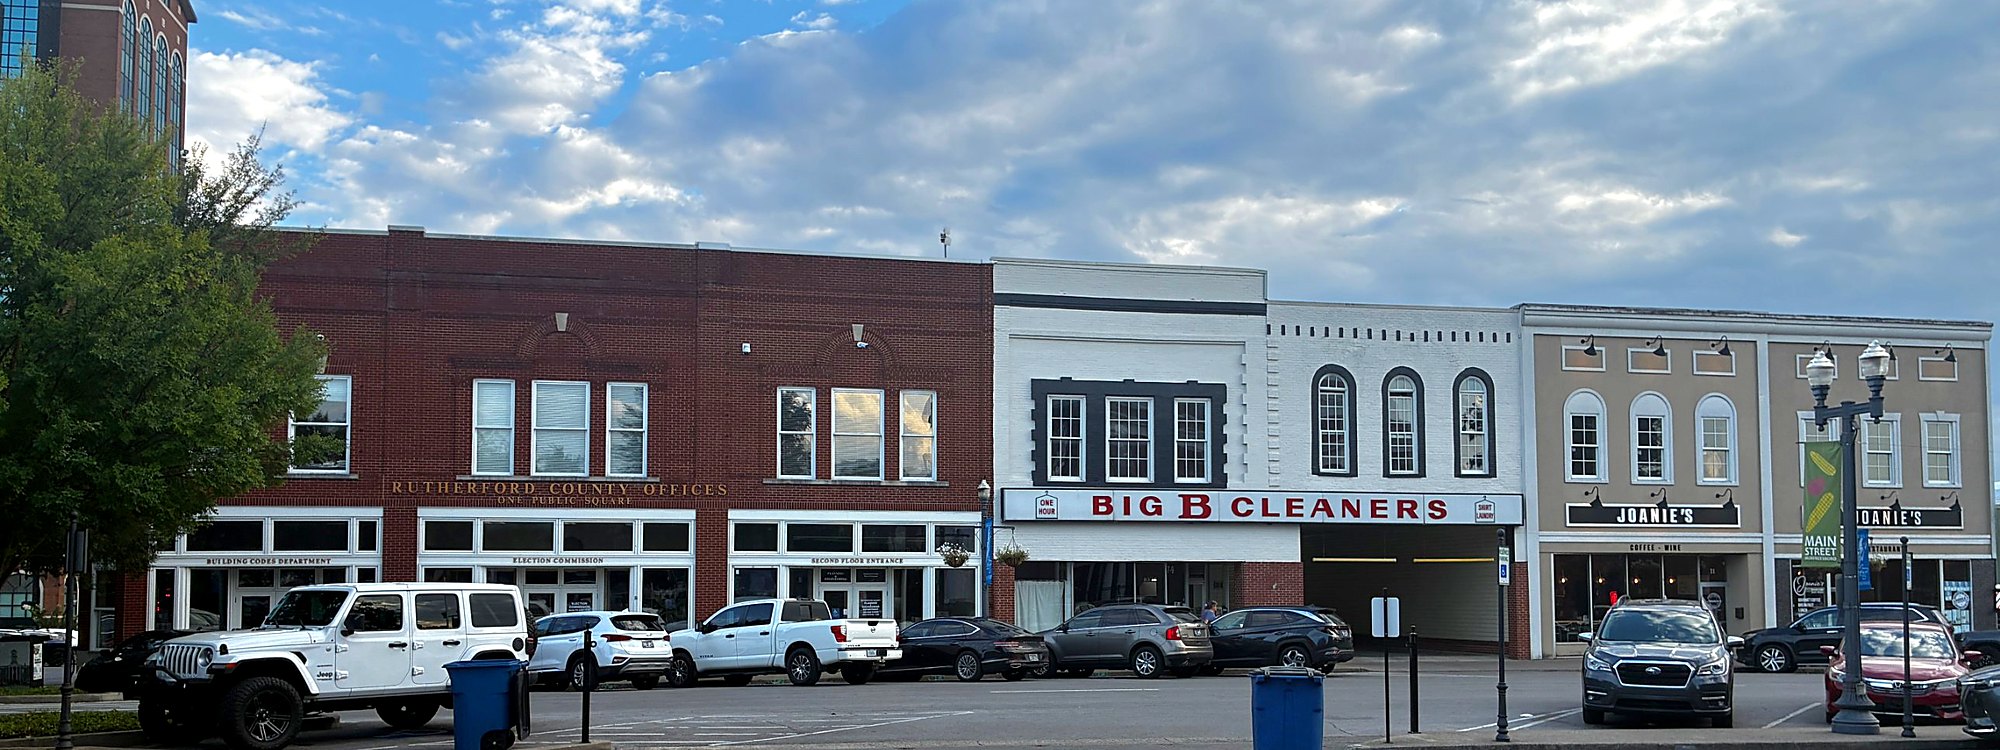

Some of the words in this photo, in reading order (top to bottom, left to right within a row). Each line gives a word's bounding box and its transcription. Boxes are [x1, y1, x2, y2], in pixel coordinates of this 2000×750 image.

[392, 481, 535, 494] RUTHERFORD
[550, 482, 629, 495] COUNTY
[643, 483, 727, 496] OFFICES
[497, 496, 523, 504] ONE
[532, 496, 576, 504] PUBLIC
[585, 497, 633, 505] SQUARE
[1092, 495, 1163, 517] BIG
[1178, 494, 1212, 519] B
[1231, 496, 1447, 520] CLEANERS
[1616, 507, 1694, 523] JOANIE'S
[1804, 535, 1837, 547] MAIN
[1804, 547, 1837, 556] STREET
